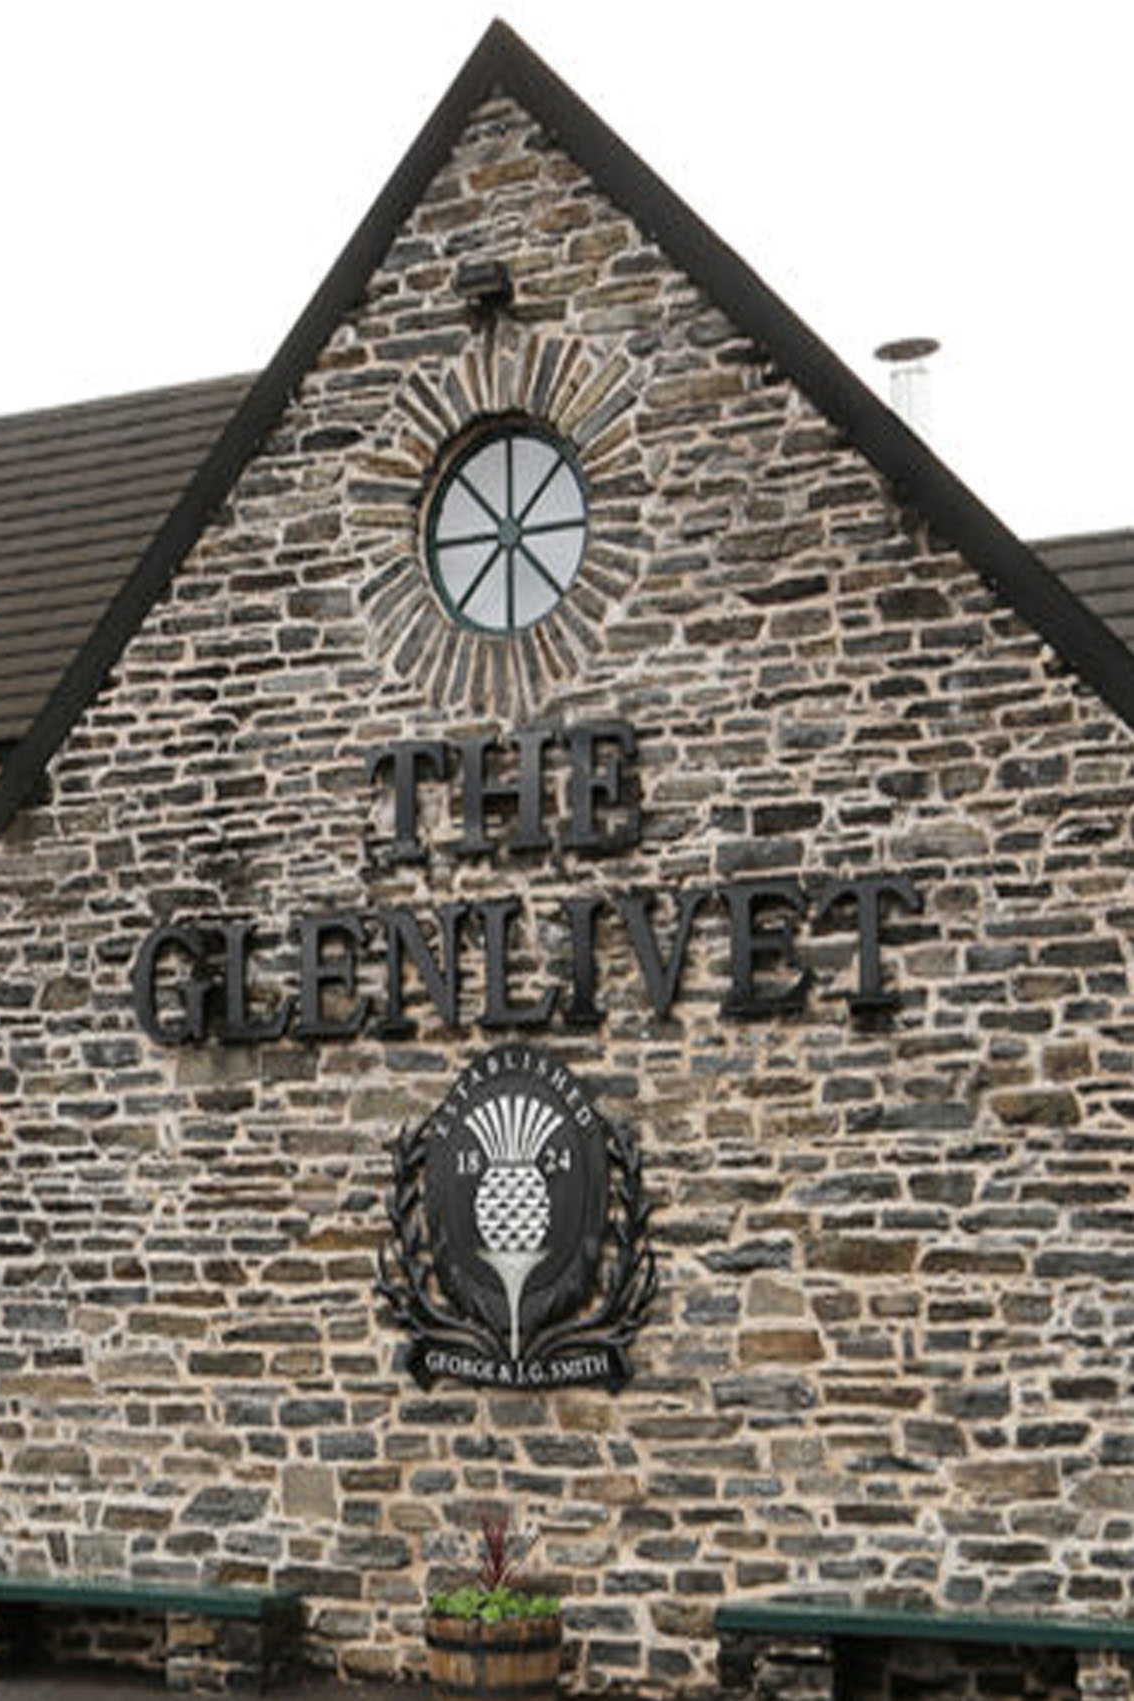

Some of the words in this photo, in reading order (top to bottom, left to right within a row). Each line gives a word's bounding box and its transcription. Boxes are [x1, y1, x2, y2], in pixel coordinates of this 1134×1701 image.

[368, 721, 642, 863] THE
[133, 877, 922, 1045] GLENLIVET
[435, 1052, 594, 1138] ESTABLISHED
[457, 1151, 480, 1175] 18
[545, 1149, 572, 1174] 24
[425, 1351, 495, 1380] GEORGE
[497, 1363, 513, 1382] &
[550, 1353, 608, 1380] SMITH
